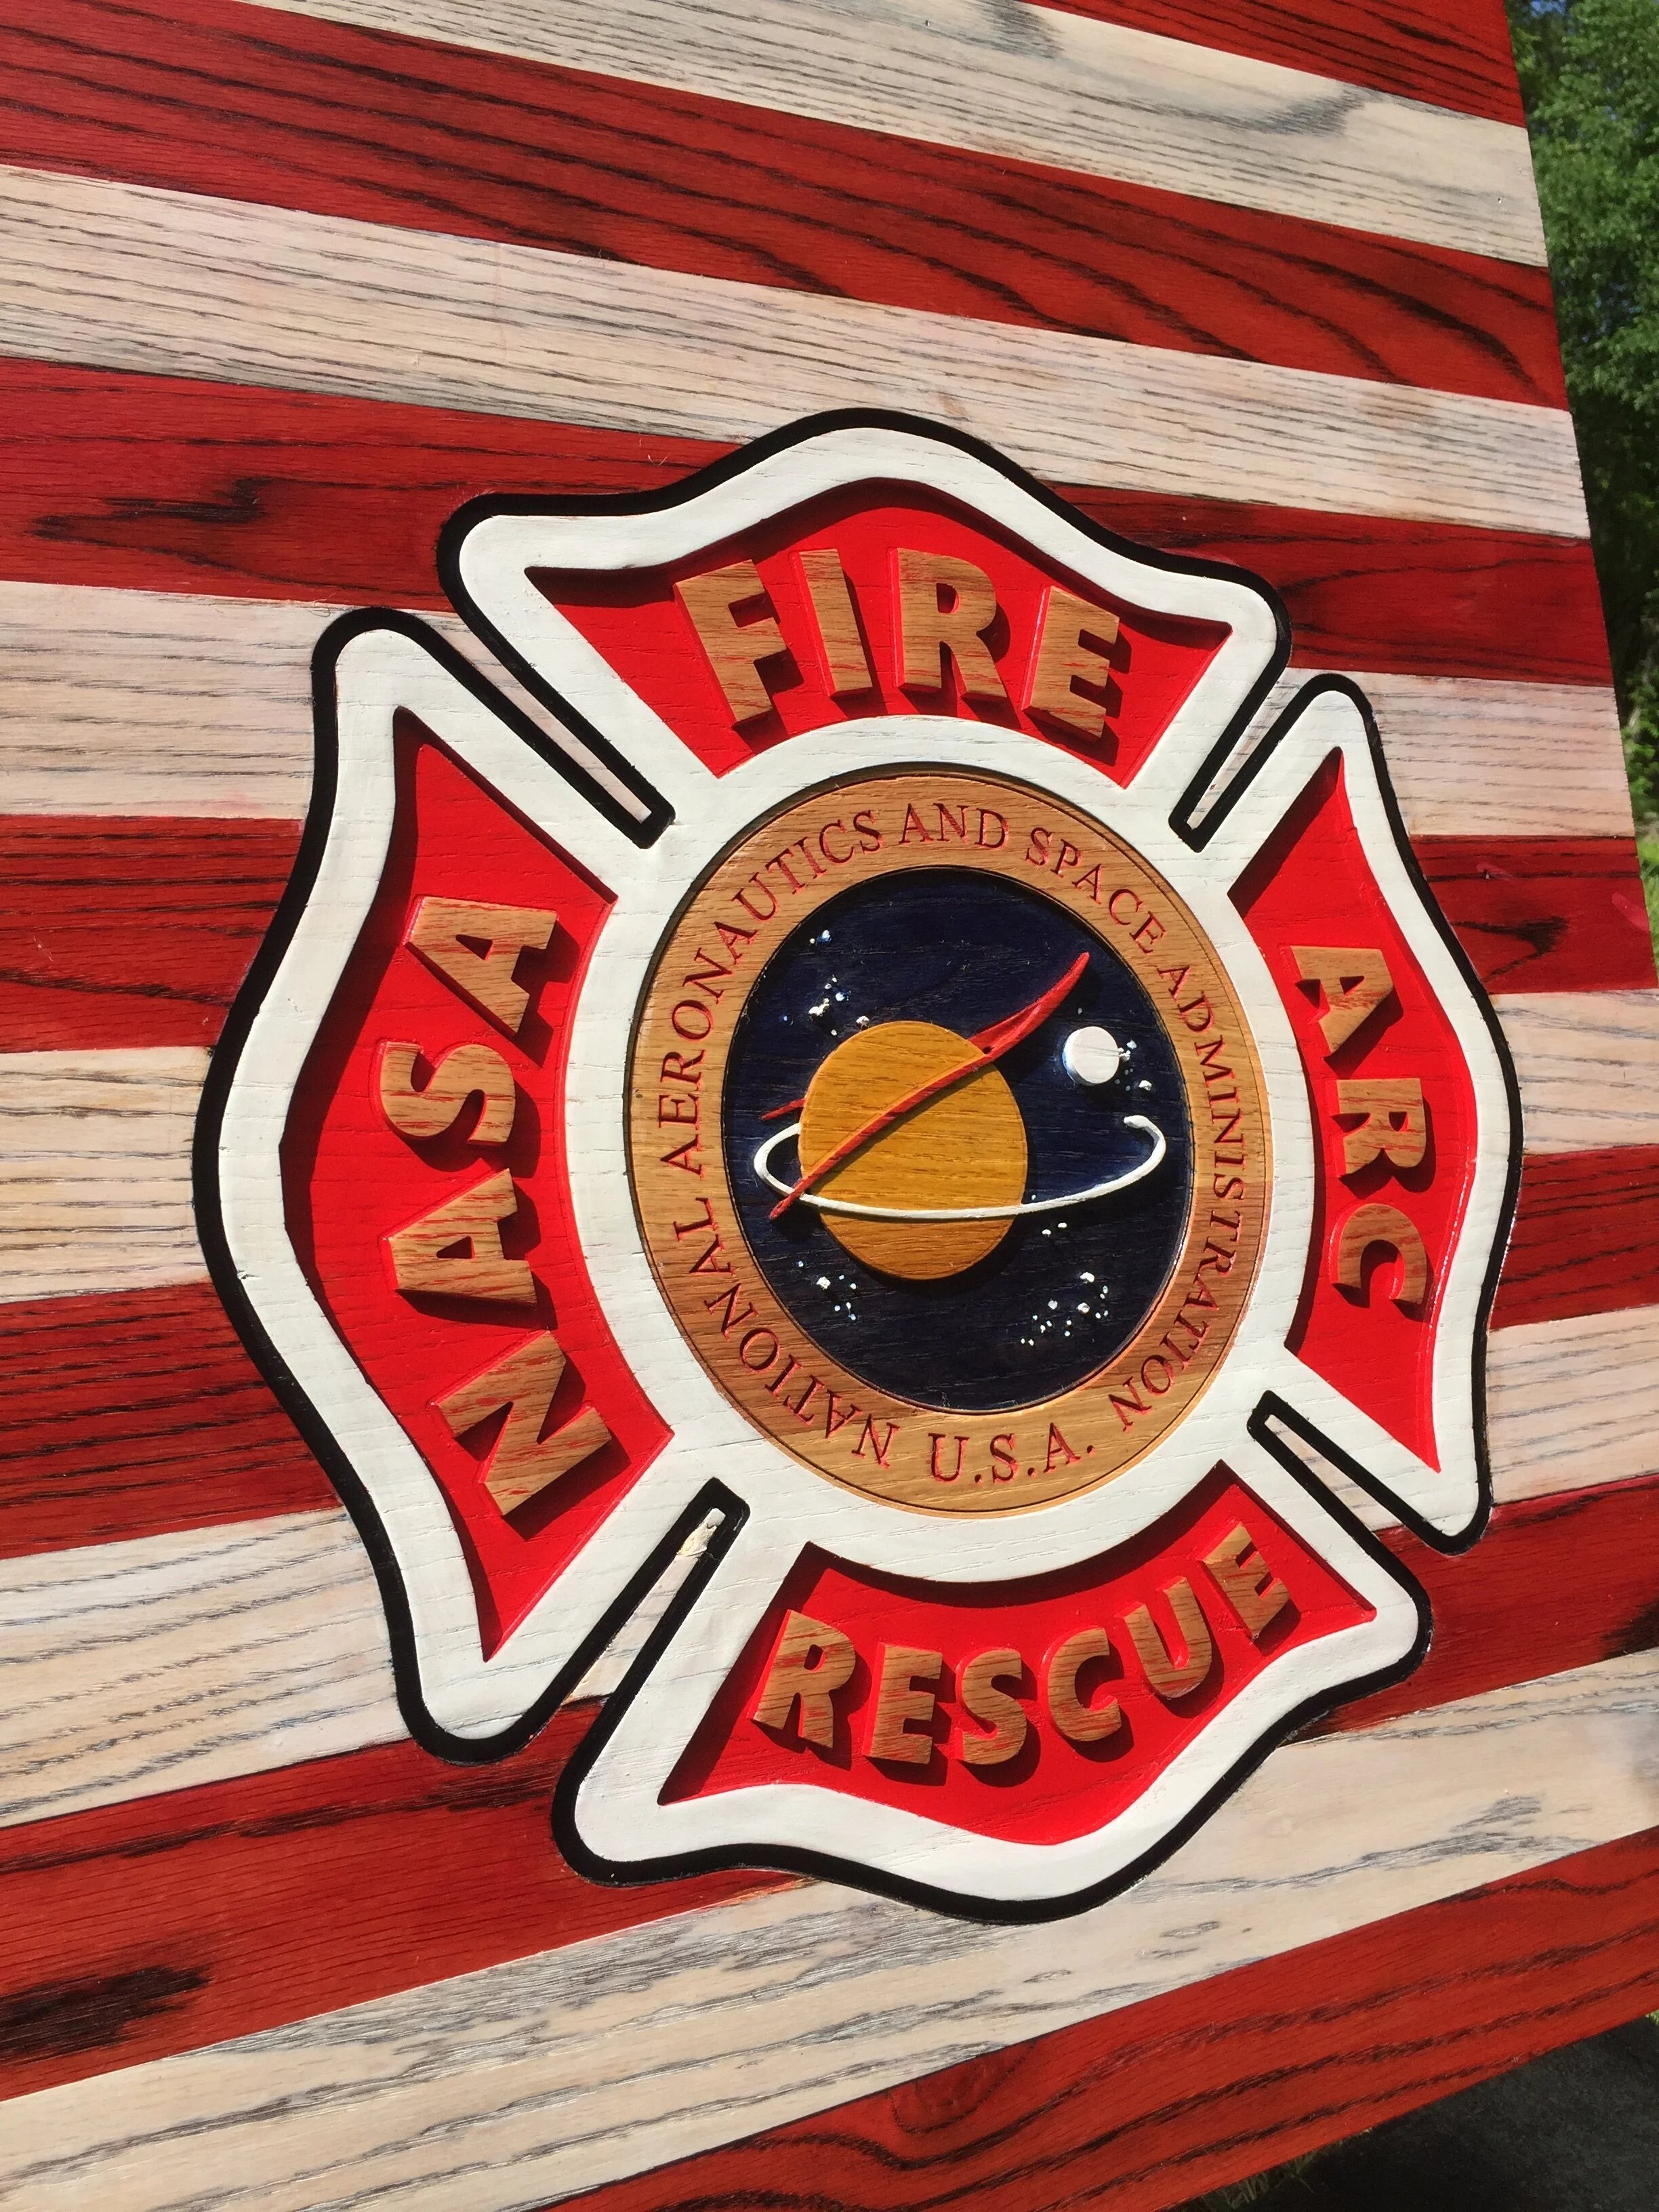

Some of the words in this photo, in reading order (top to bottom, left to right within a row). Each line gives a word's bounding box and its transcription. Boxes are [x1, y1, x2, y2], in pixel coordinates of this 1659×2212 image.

[675, 548, 1120, 737] FIRE
[899, 802, 1009, 848] AND
[1025, 827, 1166, 955] SPACE
[657, 810, 885, 1179] AERONAUTICS
[380, 896, 614, 1517] NASA
[1108, 964, 1245, 1431] ADMINISTRATION
[1291, 945, 1427, 1306] ARC
[672, 1197, 900, 1468] NATIONAL
[928, 1422, 1095, 1484] U.S.A.
[754, 1522, 1290, 1765] RESCUE
